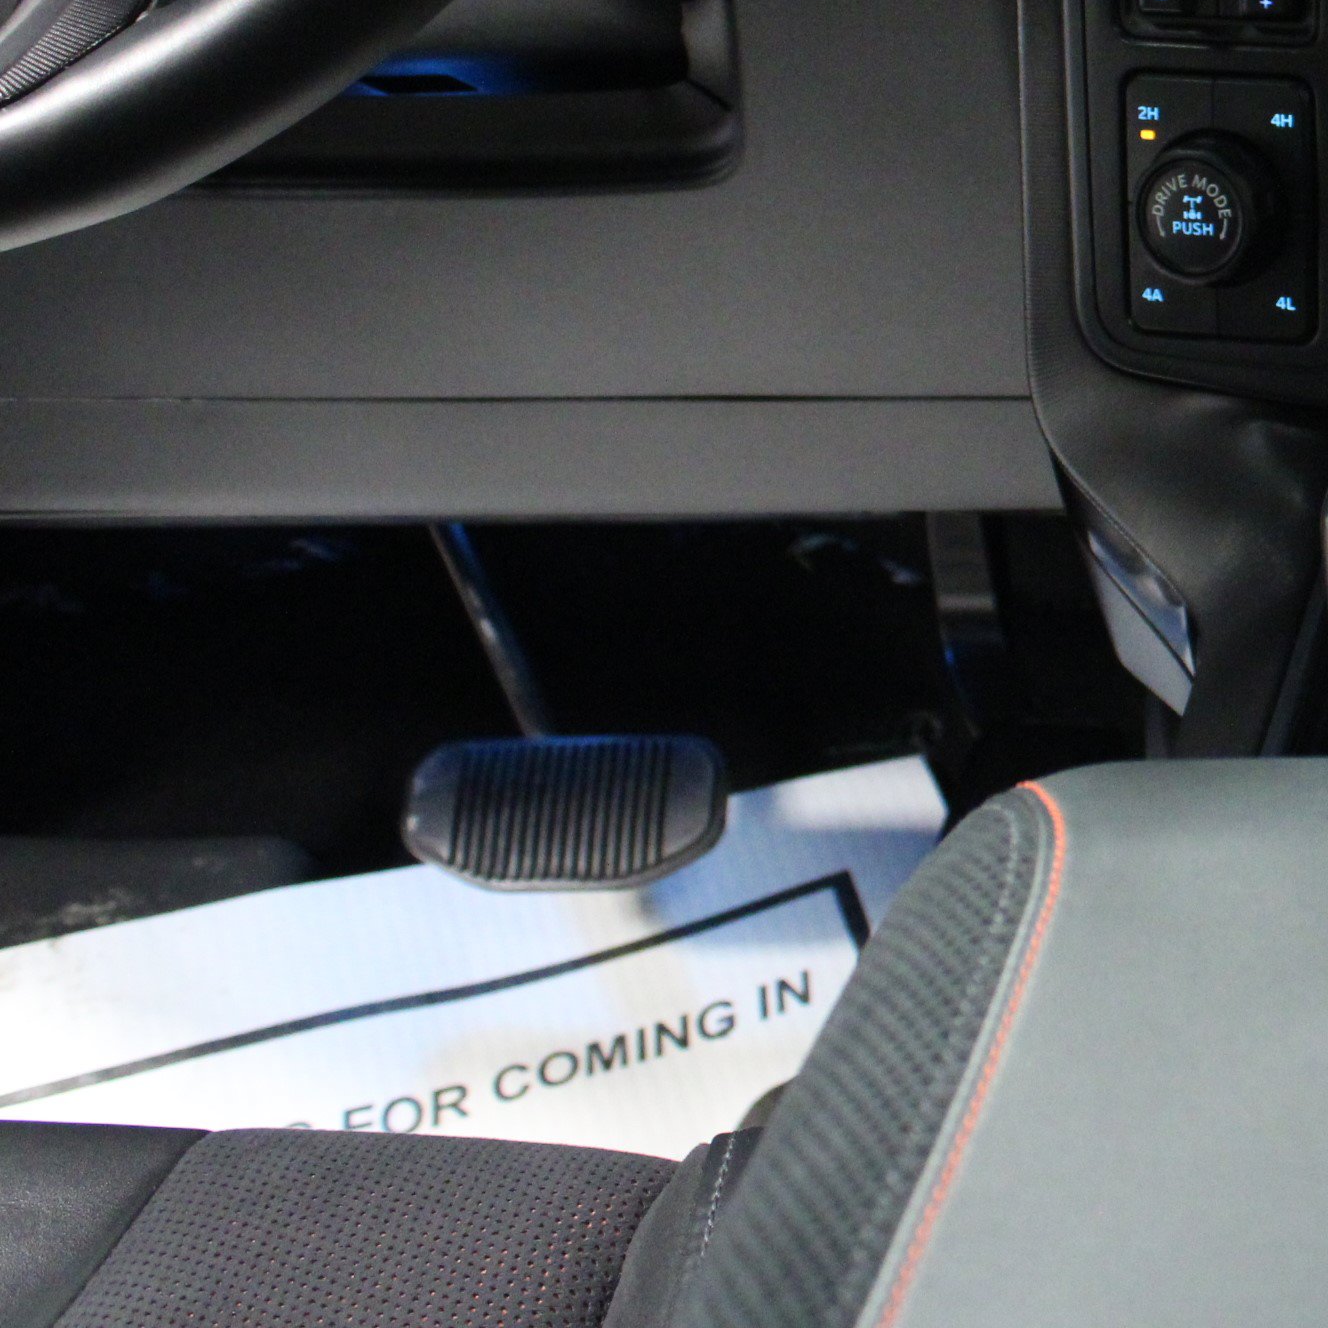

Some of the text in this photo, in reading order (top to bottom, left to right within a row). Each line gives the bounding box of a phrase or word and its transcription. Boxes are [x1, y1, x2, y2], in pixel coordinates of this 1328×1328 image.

[1138, 106, 1159, 120] 2H
[1270, 114, 1293, 127] 4H
[1152, 174, 1232, 219] DRIVE MODE
[1173, 221, 1214, 236] PUSH
[1142, 288, 1164, 302] 4A
[1276, 297, 1296, 311] 4L
[341, 970, 813, 1133] FOR COMING IN
